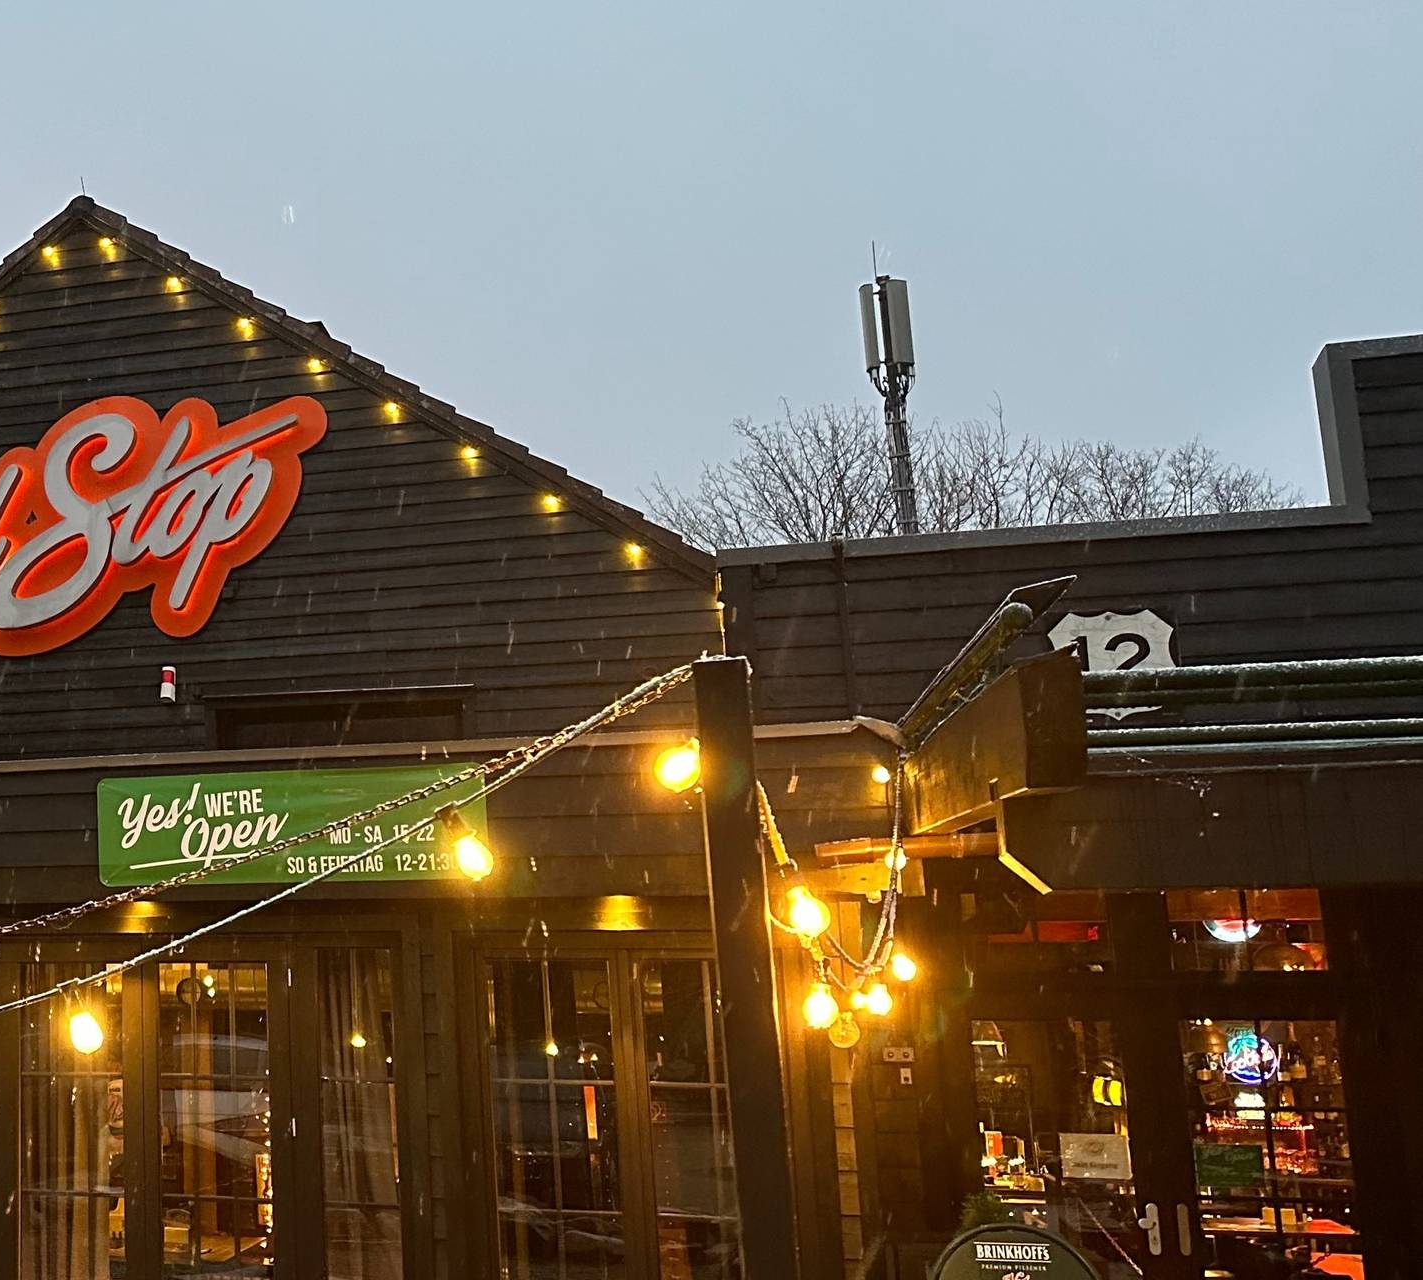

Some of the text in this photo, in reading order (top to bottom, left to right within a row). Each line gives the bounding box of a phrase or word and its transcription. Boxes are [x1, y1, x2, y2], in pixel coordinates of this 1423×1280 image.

[117, 783, 264, 849] Yes! WE'RE
[180, 812, 289, 868] Open
[330, 826, 352, 845] MO
[364, 825, 383, 843] SA
[392, 823, 435, 843] 1522
[287, 857, 305, 874] SO
[308, 856, 317, 873] &
[976, 1244, 1050, 1261] BRINKHOFF's
[981, 1263, 1012, 1271] PREMIUM
